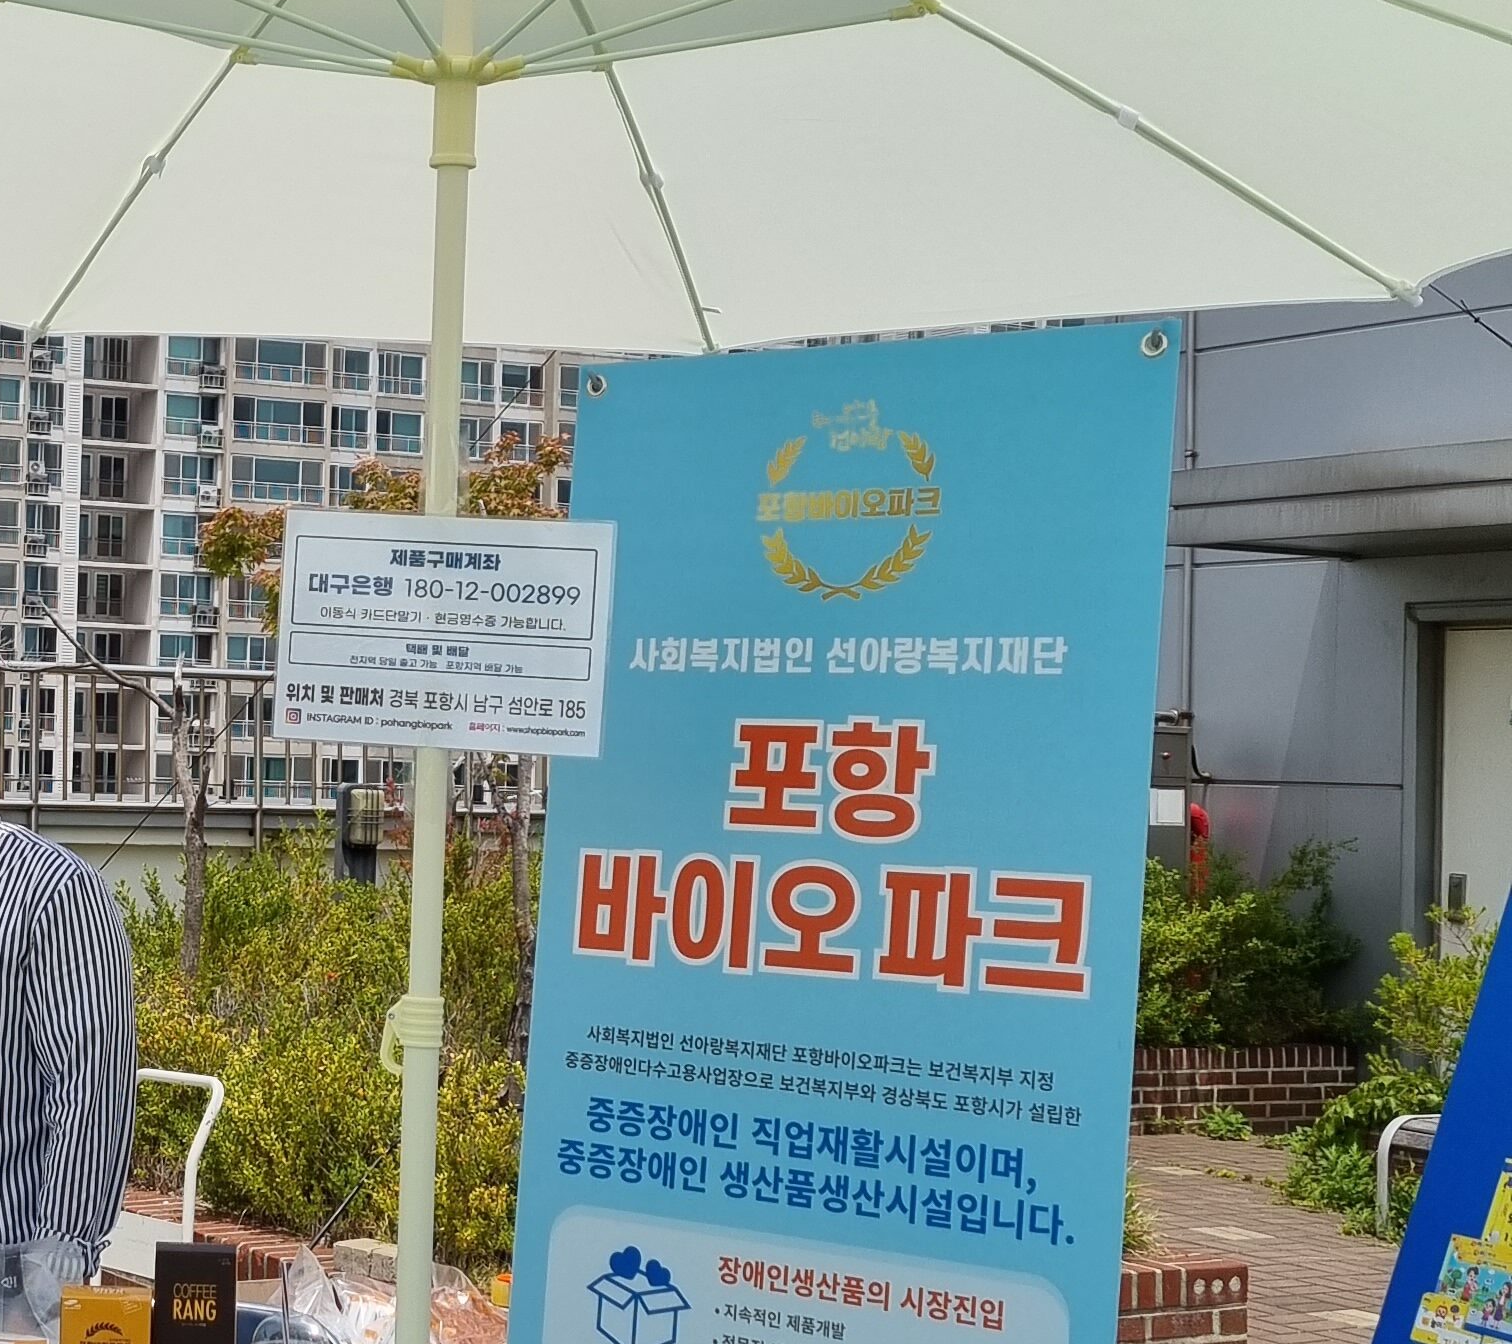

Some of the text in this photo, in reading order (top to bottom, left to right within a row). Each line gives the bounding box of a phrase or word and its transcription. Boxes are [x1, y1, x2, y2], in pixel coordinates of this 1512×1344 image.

[756, 487, 942, 522] 포항바이오파크
[390, 548, 501, 571] 제품구매계좌
[308, 573, 581, 605] 대구은행 180-12-002899
[320, 606, 567, 632] 이동식 카드단말기 현금영수증 가능합니다.
[629, 636, 1068, 676] 사회복지법인 선아랑복지재단
[285, 683, 586, 720] 위치 및 판매처 경북 포항시 남구 섬안로 185
[306, 712, 453, 731] INSTAGRAM ID pohangbiopark
[724, 714, 936, 844] 포항
[586, 1024, 1055, 1092] 사회복지법인 선아랑복지재단 포항바이오파크는 보건복지부 지정
[565, 1050, 1083, 1127] 중증장애인다수고용사업장으로 보건복지부와 경상북도 포항시가 설립한
[586, 1095, 1038, 1196] 중증장애인 직업재활시설이며,
[556, 1138, 1075, 1246] 중증장애인 생산품생산시설입니다.
[172, 1282, 217, 1300] COFFEE
[717, 1255, 1006, 1331] 장애인생산품의 시장진입
[172, 1299, 217, 1322] RANG
[722, 1303, 846, 1342] 지속적인 제품개발
